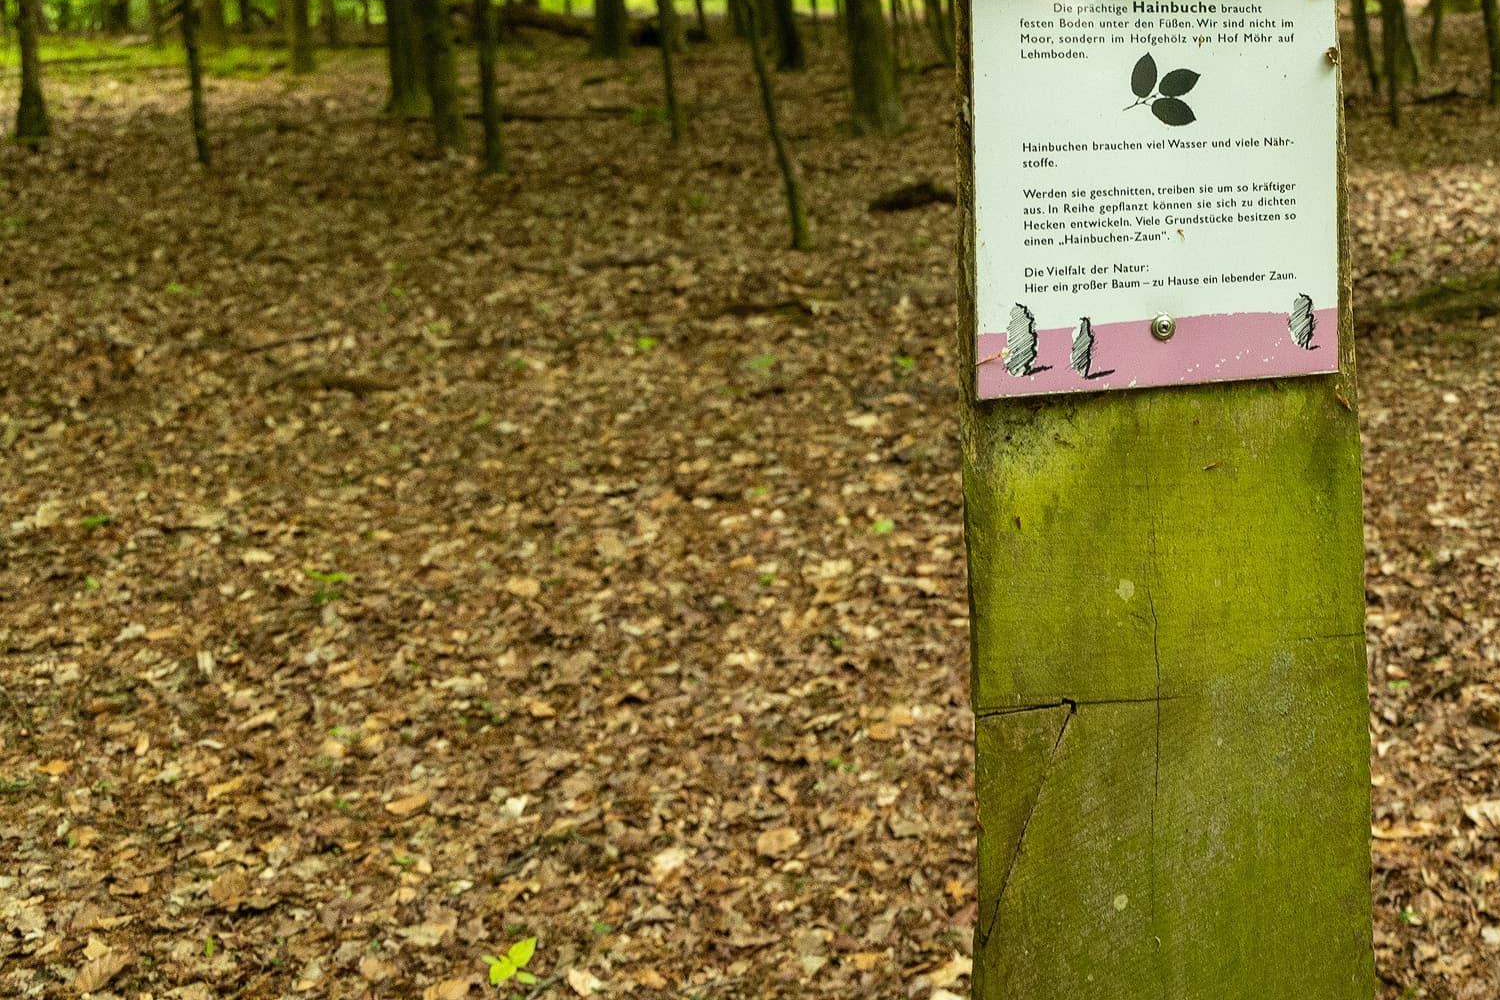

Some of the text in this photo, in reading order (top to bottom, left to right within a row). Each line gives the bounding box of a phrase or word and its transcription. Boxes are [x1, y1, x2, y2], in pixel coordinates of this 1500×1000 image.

[1054, 1, 1262, 16] Die prächtige Hainbuche braucht
[1020, 18, 1293, 28] festen Boden unter den Füßen. Wir sind nicht im
[1021, 33, 1054, 44] Moor,
[1059, 34, 1105, 44] sondern
[1112, 34, 1124, 43] im
[1131, 33, 1187, 46] Hofgehölz
[1218, 33, 1238, 43] Hof
[1244, 33, 1272, 43] Möhr
[1278, 33, 1294, 42] auf
[1021, 49, 1088, 59] Lehmboden.
[1023, 137, 1294, 152] Hainbuchen brauchen viel Wasser und viele Nähr-
[1023, 157, 1057, 168] stoffe.
[1023, 188, 1067, 199] Werden
[1072, 188, 1086, 198] sie
[1090, 186, 1154, 200] geschnitten,
[1158, 184, 1195, 195] treiben
[1199, 184, 1213, 193] sie
[1253, 181, 1296, 193] kräftiger
[1024, 207, 1045, 215] aus.
[1049, 204, 1058, 214] In
[1064, 203, 1094, 213] Reihe
[1099, 200, 1148, 215] gepflanzt
[1153, 201, 1192, 210] können
[1197, 200, 1211, 209] sie
[1217, 198, 1236, 208] sich
[1258, 196, 1296, 206] dichten
[1024, 220, 1065, 231] Hecken
[1071, 217, 1131, 229] entwickeln.
[1136, 216, 1160, 226] Viele
[1165, 213, 1233, 225] Grundstücke
[1238, 212, 1280, 222] besitzen
[1024, 236, 1053, 246] einen
[1025, 264, 1149, 277] Die Vielfalt der Natur:
[1025, 283, 1049, 293] Hier
[1053, 282, 1068, 292] ein
[1072, 280, 1108, 294] großer
[1112, 279, 1140, 288] Baum
[1168, 276, 1199, 286] Hause
[1203, 275, 1217, 284] ein
[1222, 272, 1266, 283] lebender
[1269, 271, 1296, 280] Zaun.
